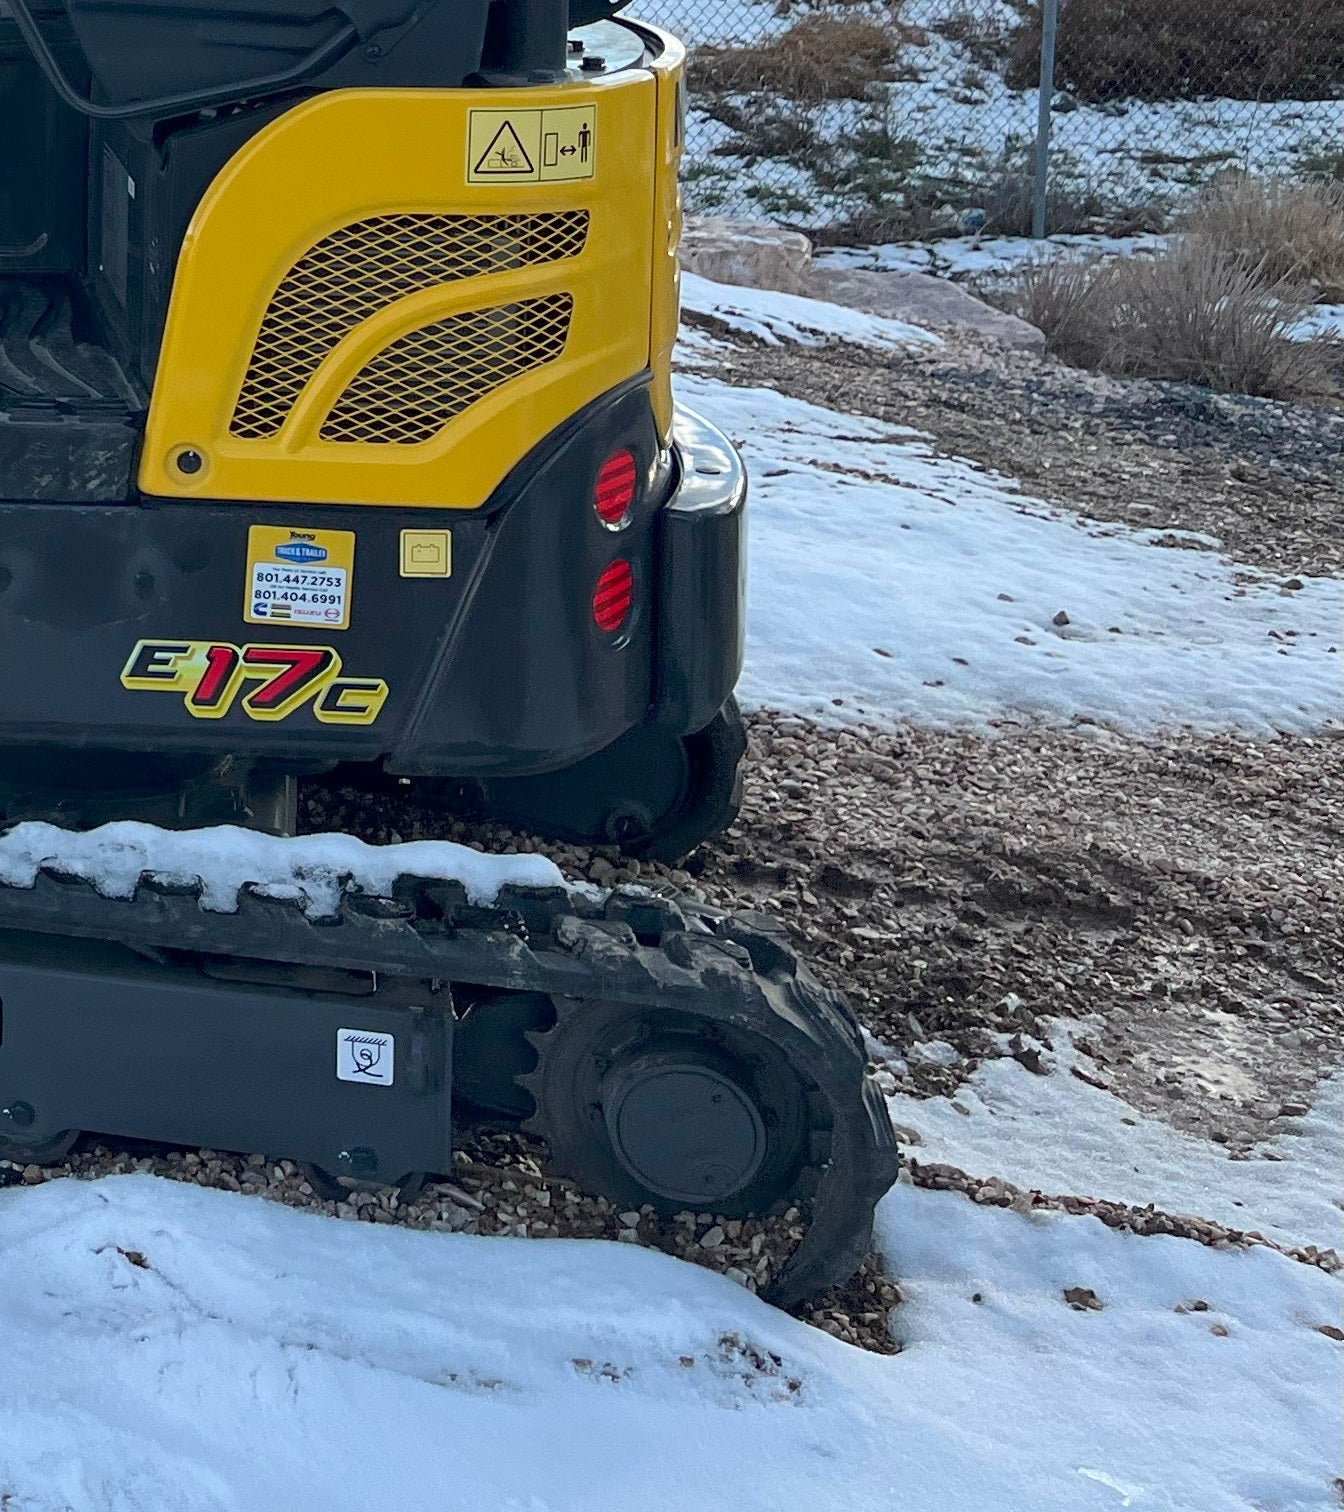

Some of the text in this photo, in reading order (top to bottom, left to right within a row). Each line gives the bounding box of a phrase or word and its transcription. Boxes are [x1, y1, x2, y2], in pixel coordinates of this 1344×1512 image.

[256, 572, 342, 588] 801.447.2753
[254, 589, 342, 605] 801.404.6991
[122, 642, 386, 719] E17C
